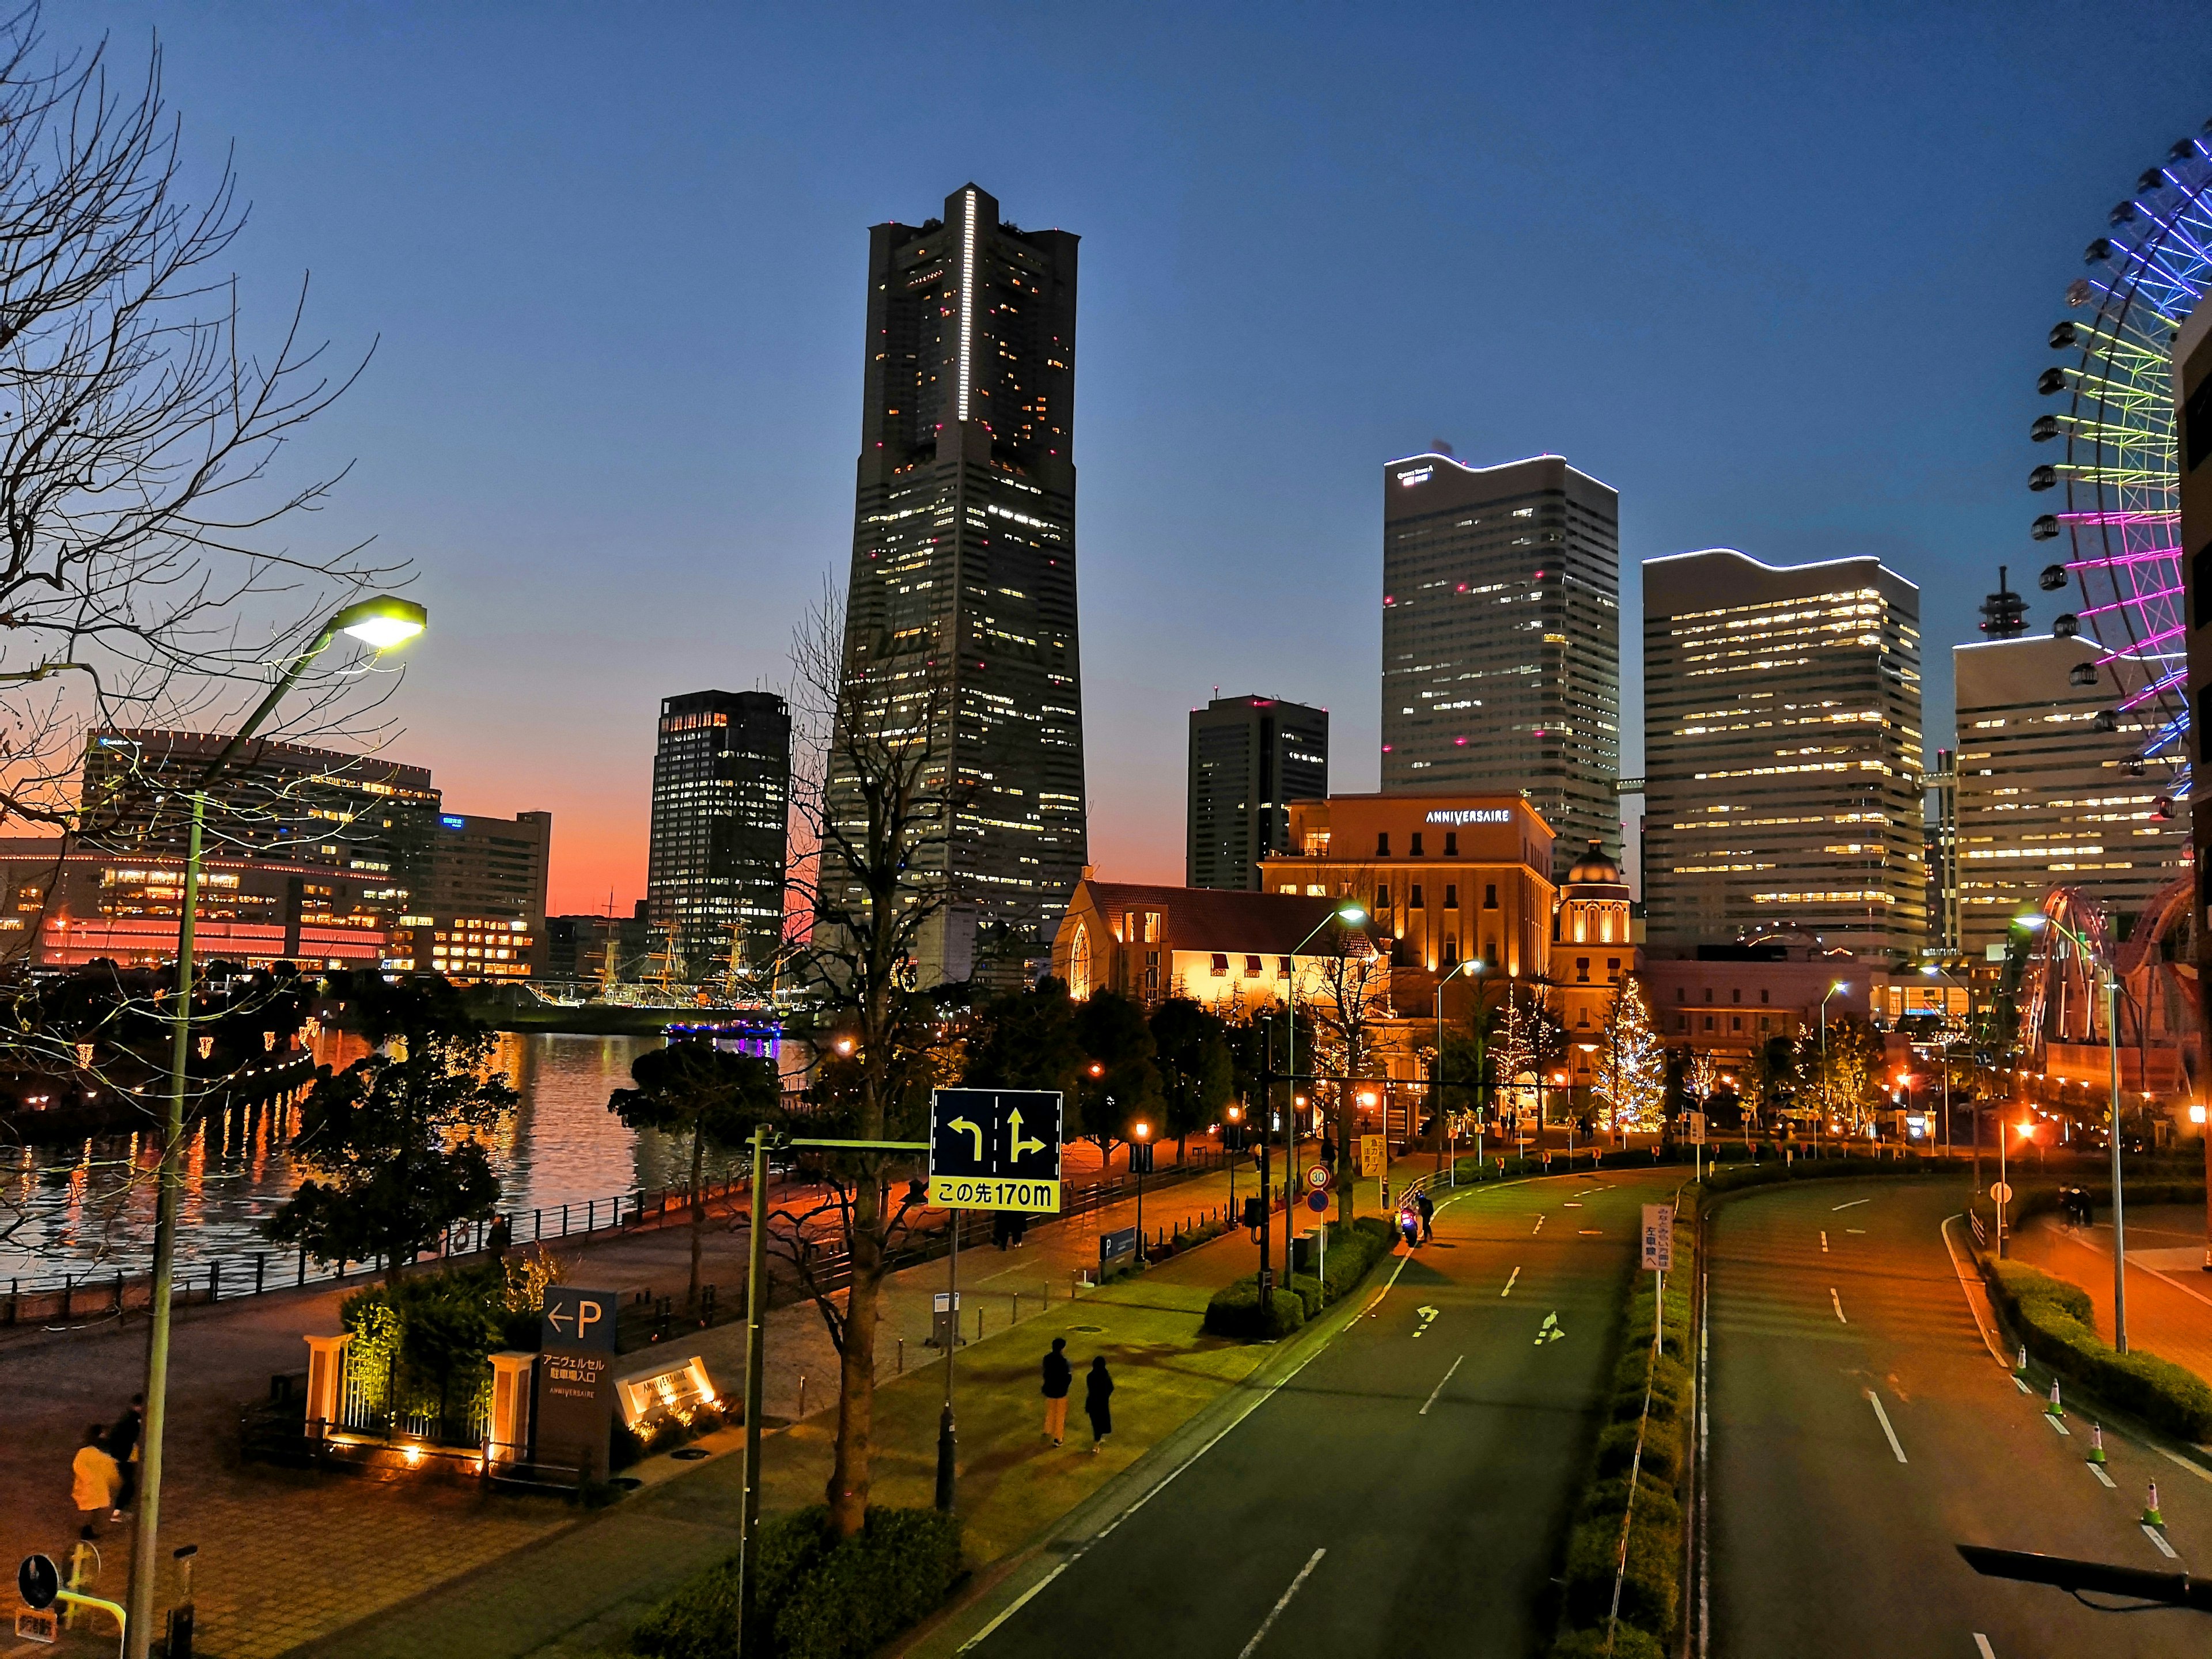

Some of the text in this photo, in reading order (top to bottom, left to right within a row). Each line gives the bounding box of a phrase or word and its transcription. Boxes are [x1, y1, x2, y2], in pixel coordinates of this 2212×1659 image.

[1426, 810, 1509, 826] ANNIVERSAIRE
[1312, 1172, 1324, 1183] 30
[939, 1183, 1051, 1206] この先170m
[1106, 1238, 1112, 1257] P
[578, 1300, 602, 1339] P
[543, 1354, 605, 1370] アニヴェルセル
[550, 1387, 595, 1398] ANNIVERSAIRE
